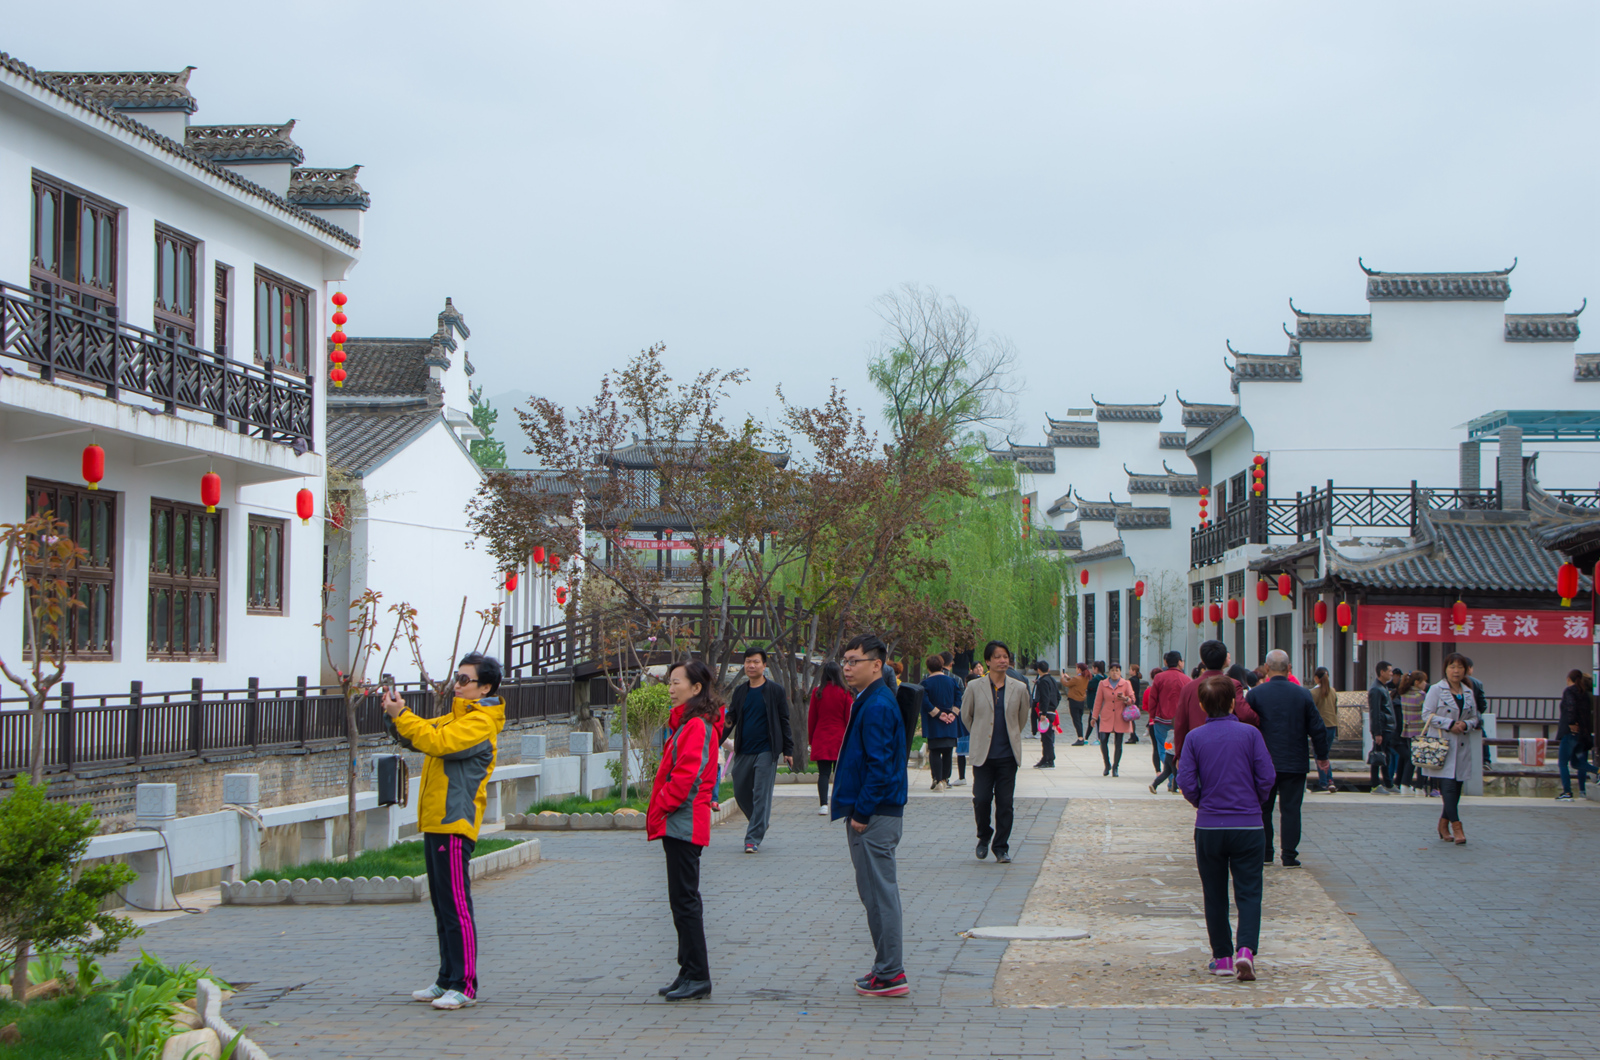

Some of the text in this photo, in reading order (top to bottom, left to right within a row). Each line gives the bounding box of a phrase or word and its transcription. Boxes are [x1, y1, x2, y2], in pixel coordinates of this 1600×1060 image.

[1384, 611, 1590, 639] 满园春意浓 荡
